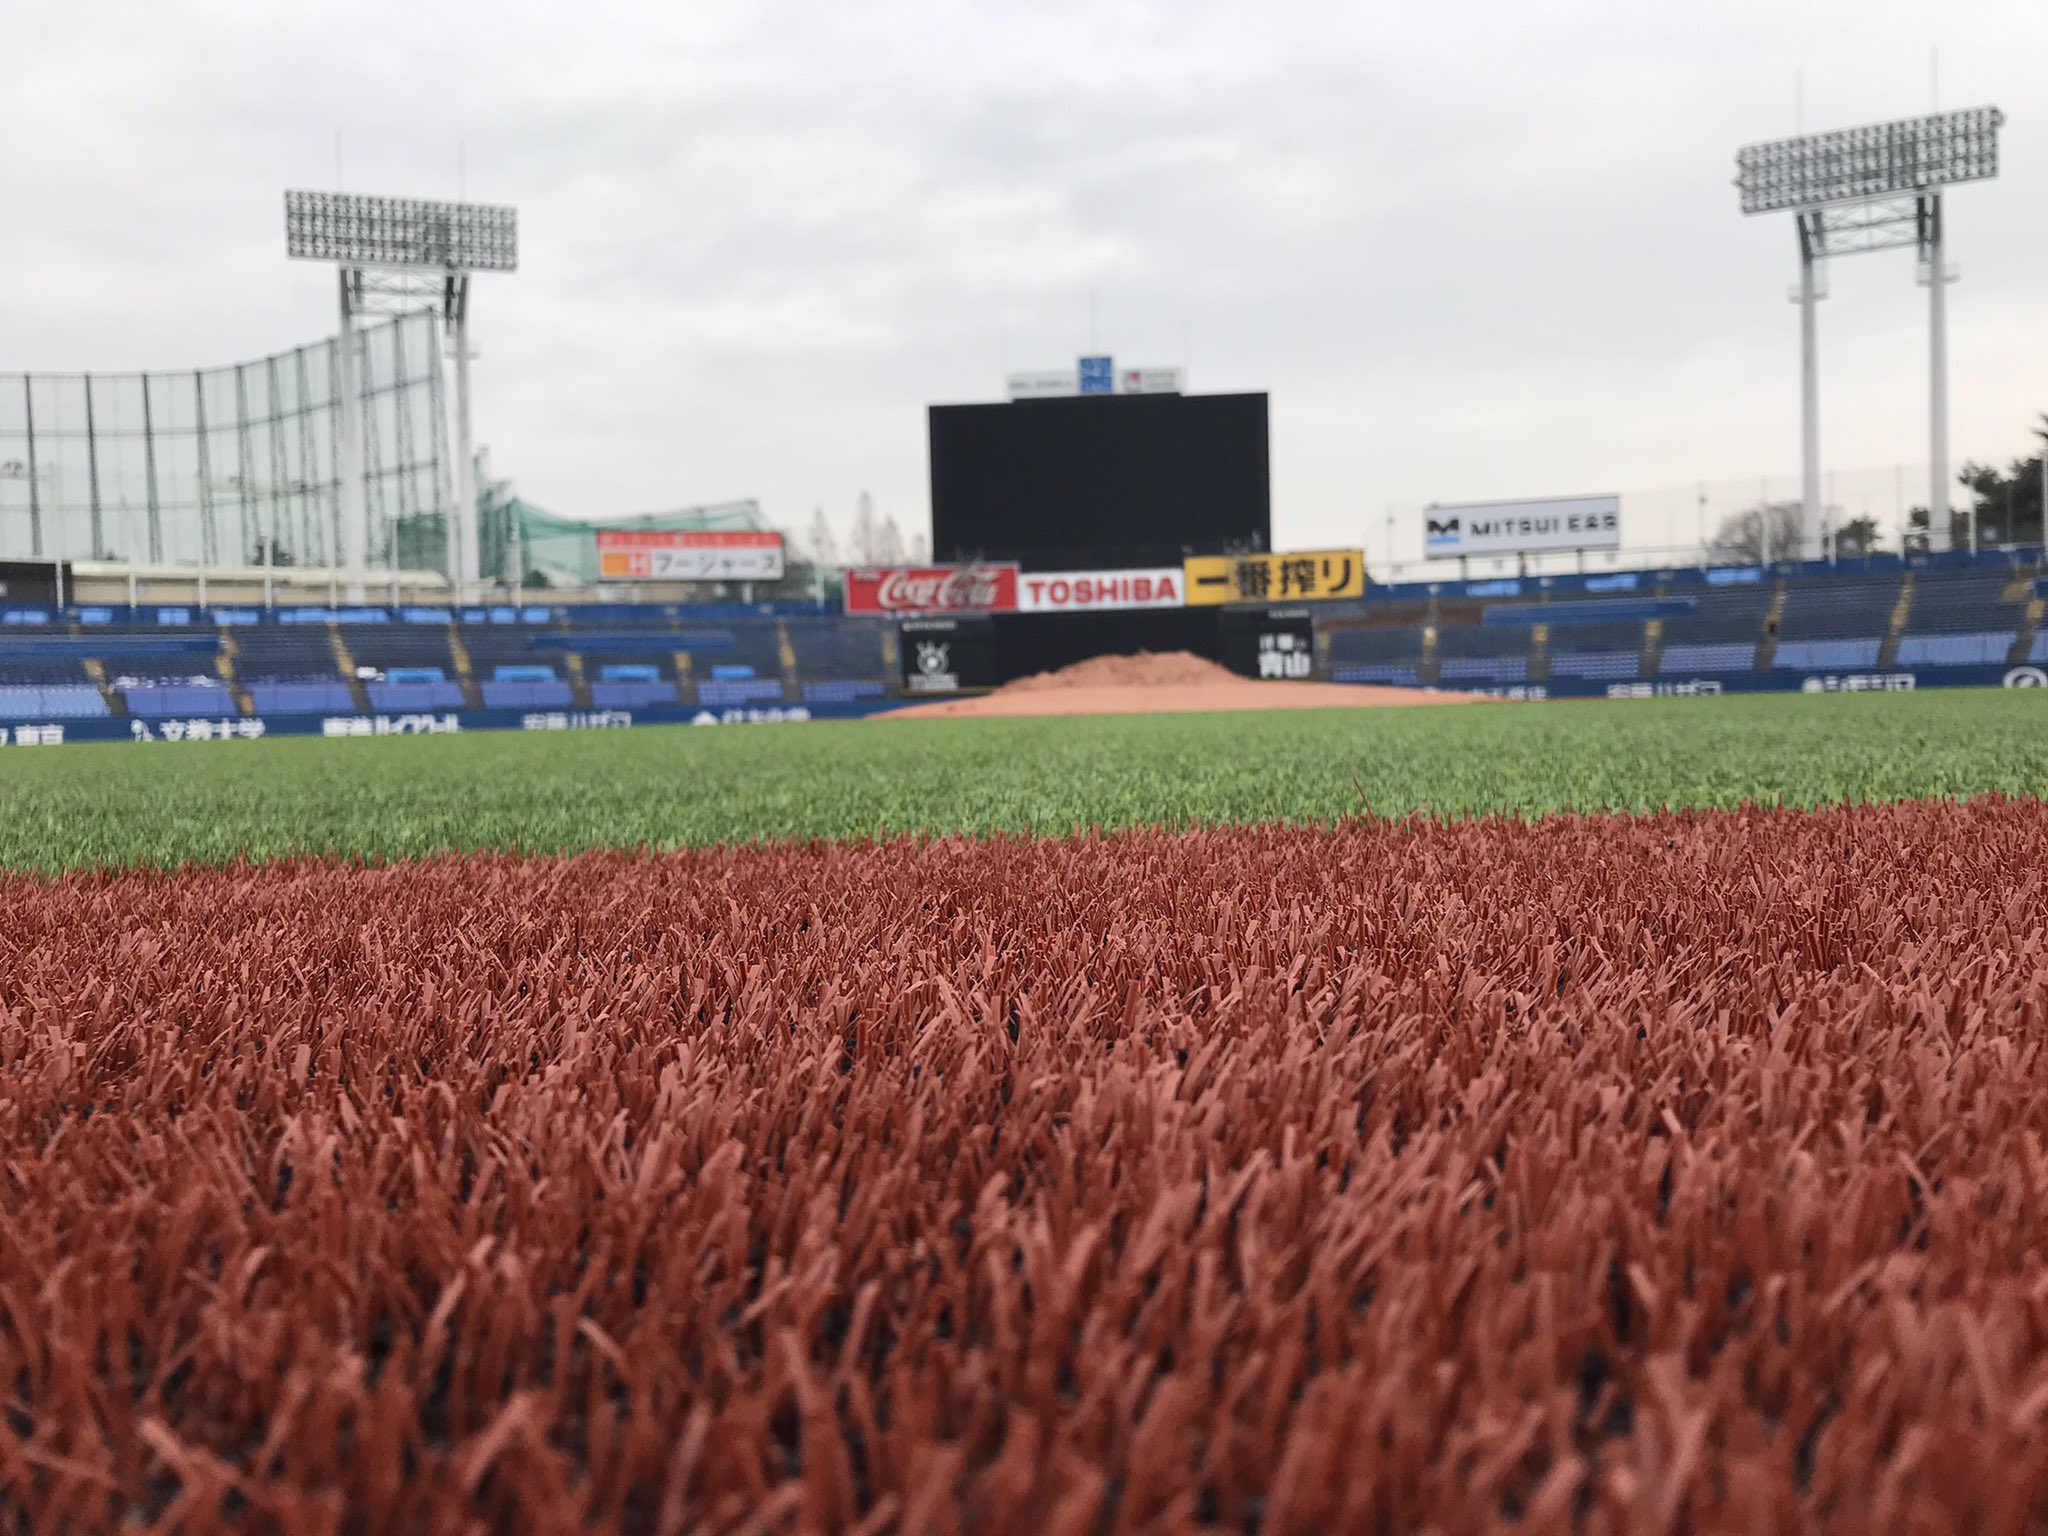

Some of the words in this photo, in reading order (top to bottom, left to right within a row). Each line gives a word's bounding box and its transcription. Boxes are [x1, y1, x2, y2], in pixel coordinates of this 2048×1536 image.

[1471, 516, 1560, 537] MITSUI
[1567, 512, 1617, 532] E&S
[654, 551, 777, 575] フージャース
[1196, 557, 1352, 597] 一番搾り
[1028, 577, 1177, 605] TOSHIBA
[1258, 650, 1312, 679] 青山
